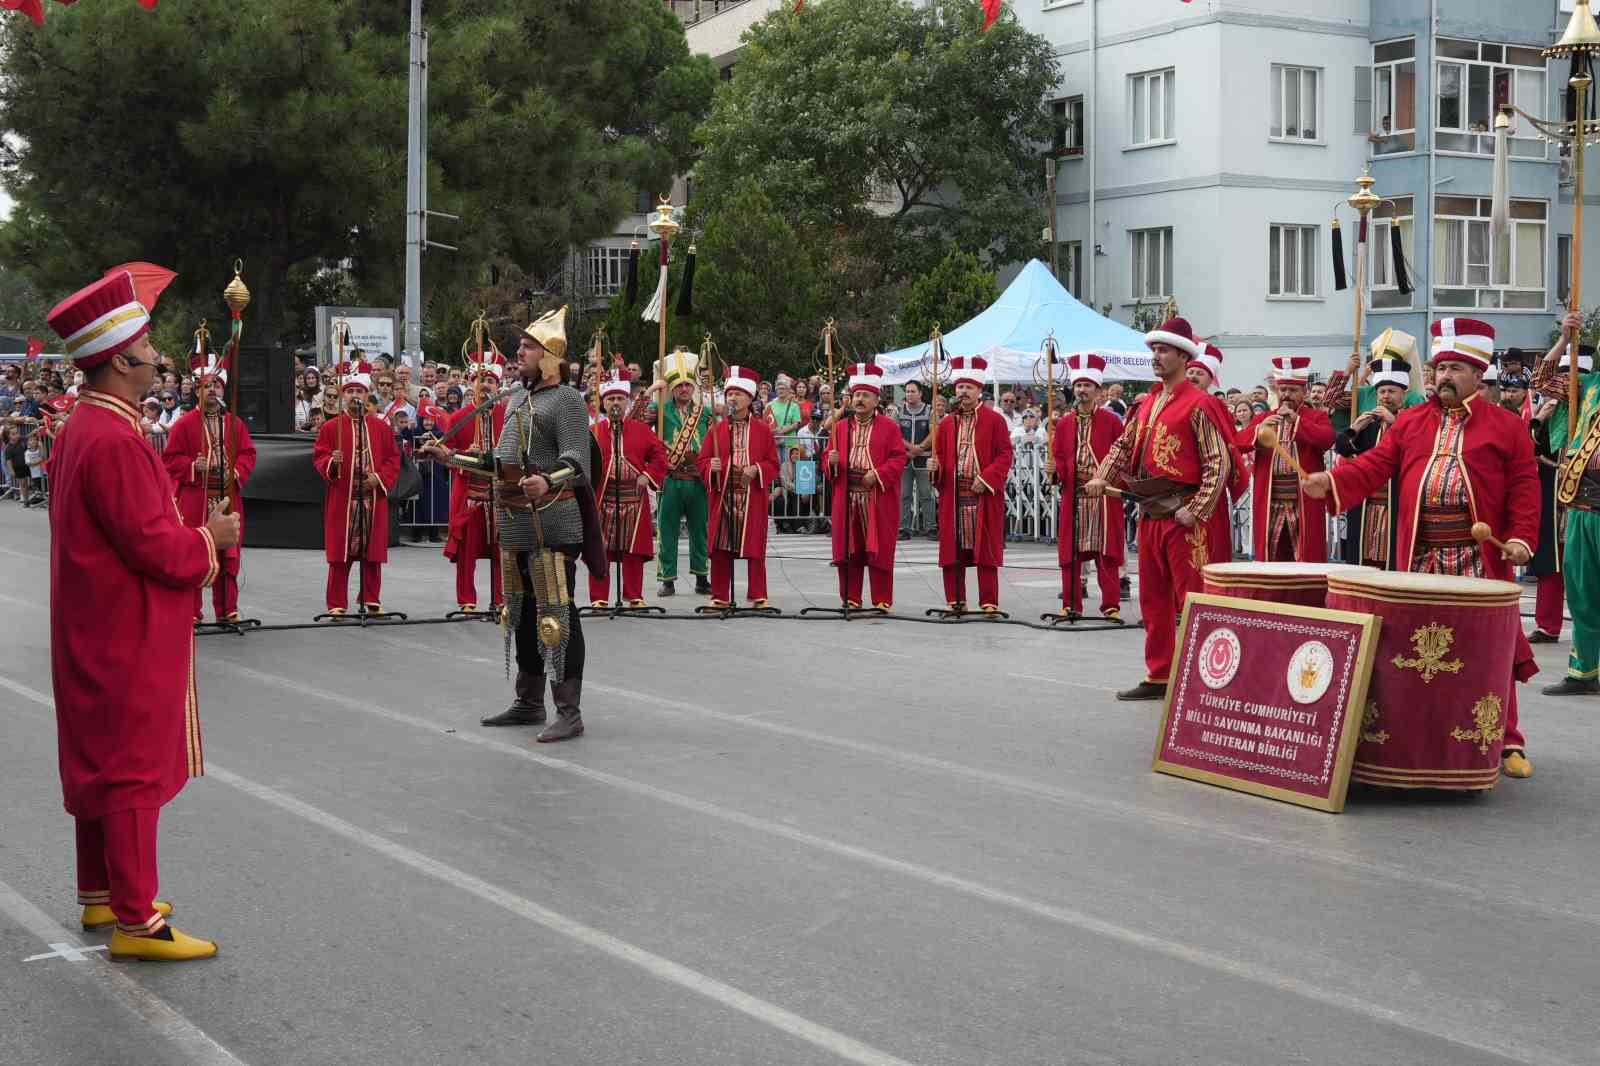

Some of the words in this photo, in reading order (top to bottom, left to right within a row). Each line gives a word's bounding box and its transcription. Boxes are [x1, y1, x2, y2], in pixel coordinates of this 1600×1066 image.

[1199, 692, 1241, 712] TÜRKİYE
[1243, 703, 1318, 727] CUMHURİYETİ
[1185, 708, 1212, 724] MİLLİ
[1214, 716, 1262, 736] SAVUNMA
[1264, 726, 1323, 748] BAKANLIĞI
[1201, 730, 1256, 753] MEHTERAN
[1257, 740, 1298, 761] BİRLİĞİ
